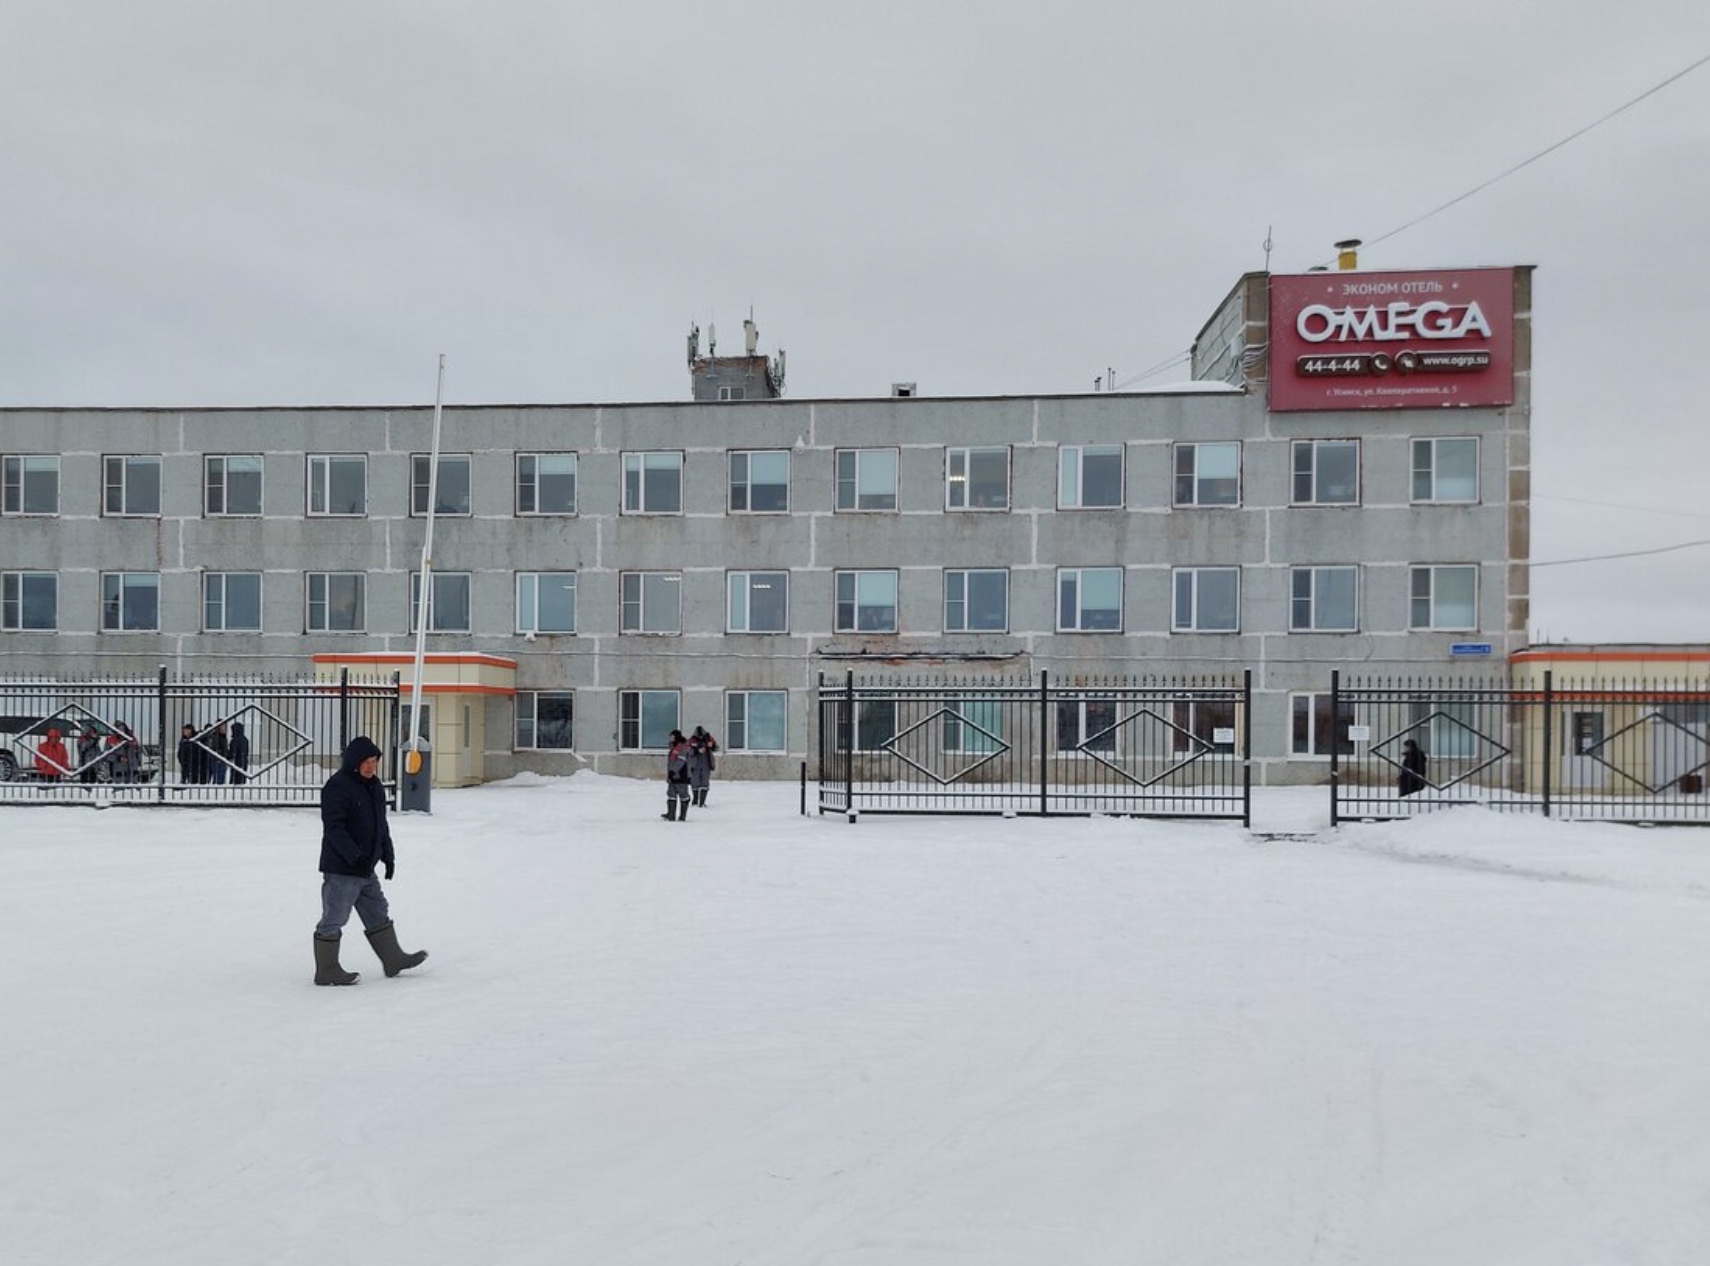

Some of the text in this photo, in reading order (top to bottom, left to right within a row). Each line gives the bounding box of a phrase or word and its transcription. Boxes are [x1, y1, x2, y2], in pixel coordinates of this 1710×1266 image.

[1342, 282, 1443, 296] ЭКОНОМ ОТЕЛЬ
[1297, 300, 1491, 342] OMEGA
[1304, 358, 1361, 373] 44-4-44
[1423, 355, 1489, 366] www.ogrp.su
